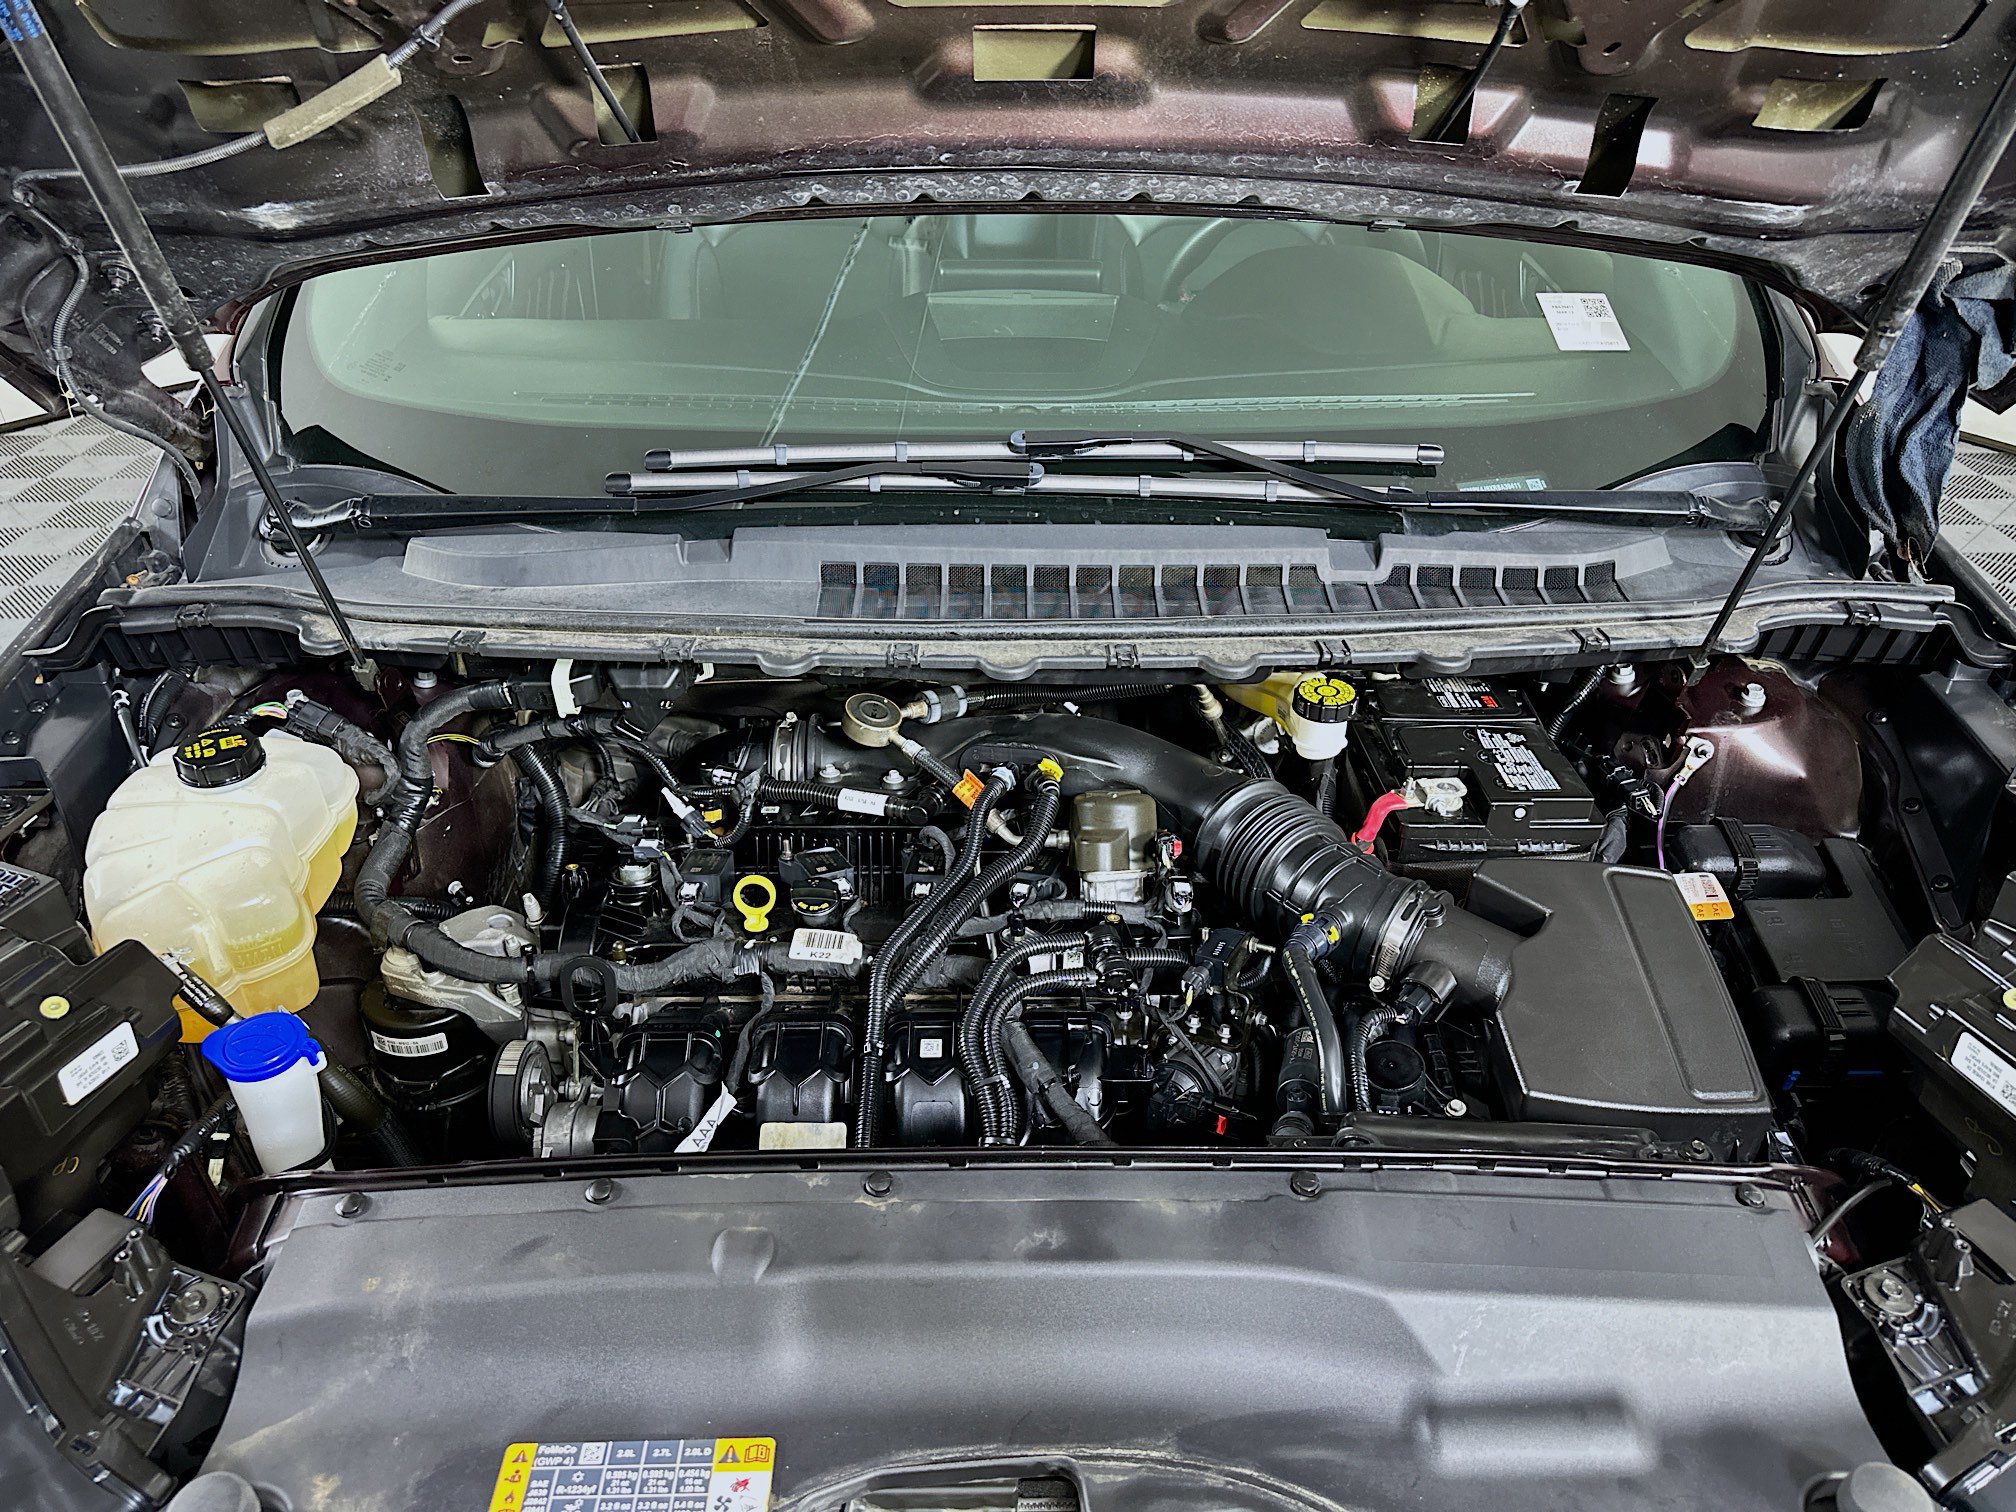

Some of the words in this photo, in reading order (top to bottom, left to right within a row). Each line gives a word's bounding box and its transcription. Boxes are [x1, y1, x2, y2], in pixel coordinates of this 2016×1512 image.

[1696, 903, 1705, 918] CAE
[1711, 902, 1721, 917] CAE
[810, 951, 832, 959] K22
[533, 1456, 563, 1467] (GWP
[563, 1456, 575, 1467] 4)
